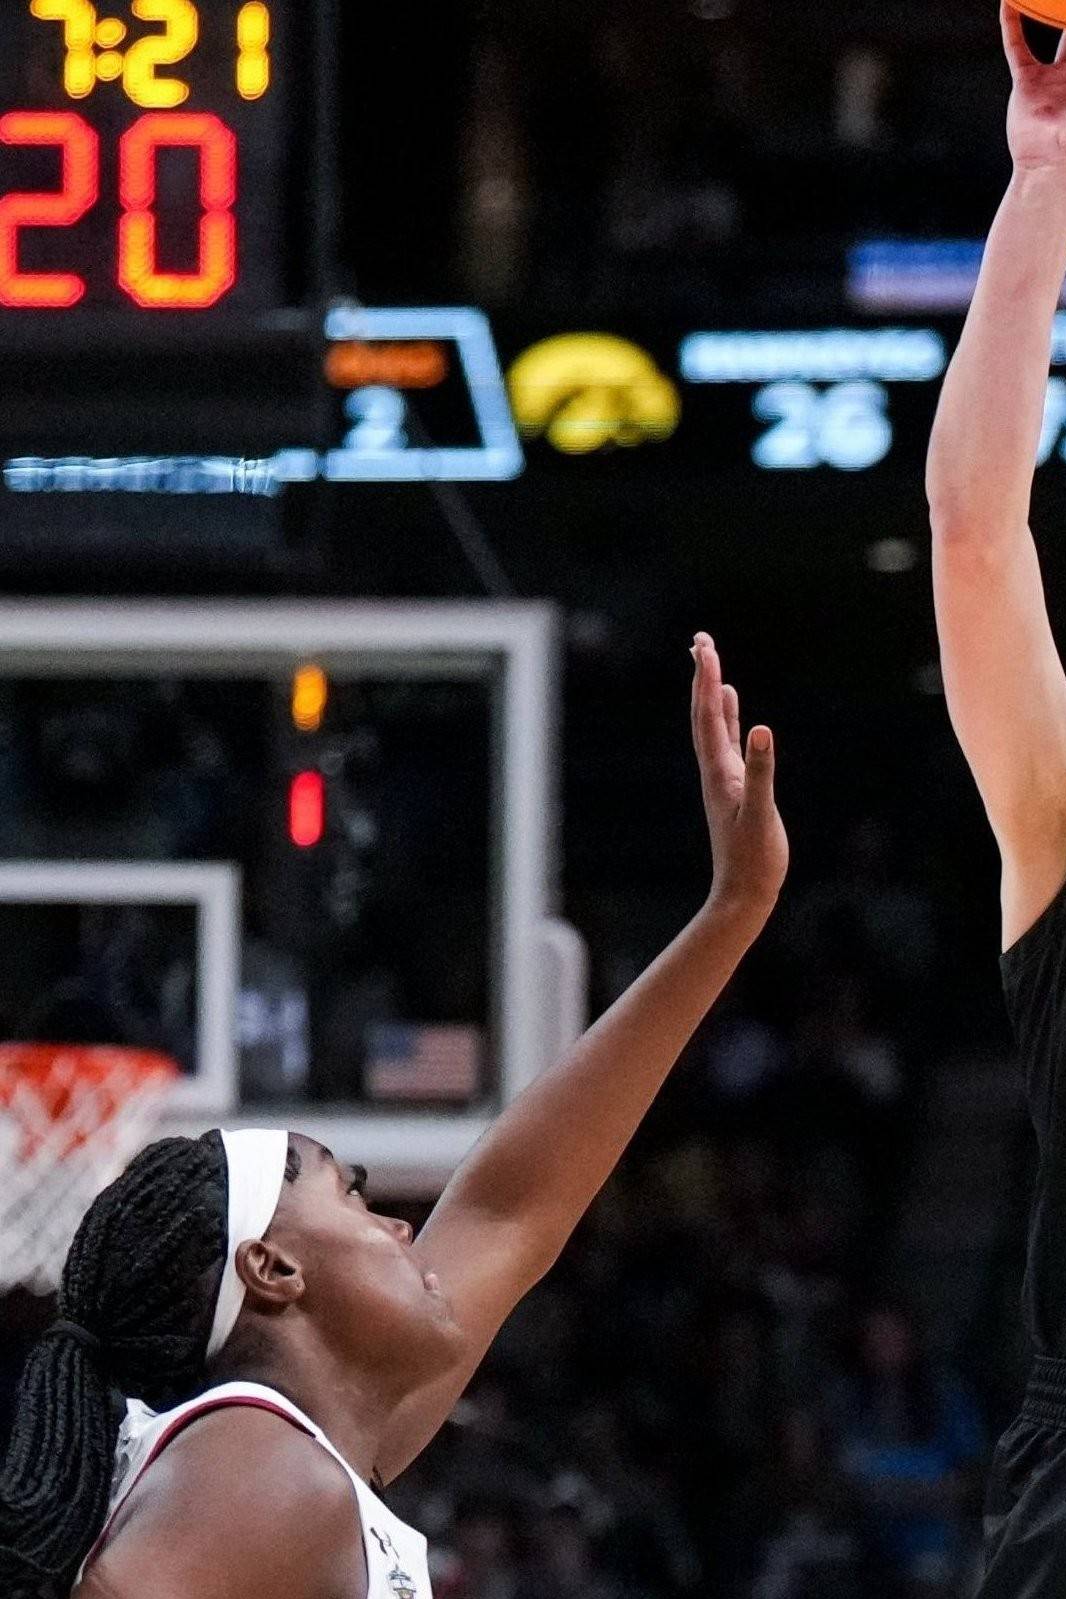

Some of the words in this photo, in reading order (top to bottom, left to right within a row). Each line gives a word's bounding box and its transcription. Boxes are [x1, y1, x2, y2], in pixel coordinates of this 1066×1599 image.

[30, 0, 270, 107] 7:21
[0, 112, 237, 308] 20
[751, 379, 892, 470] 26
